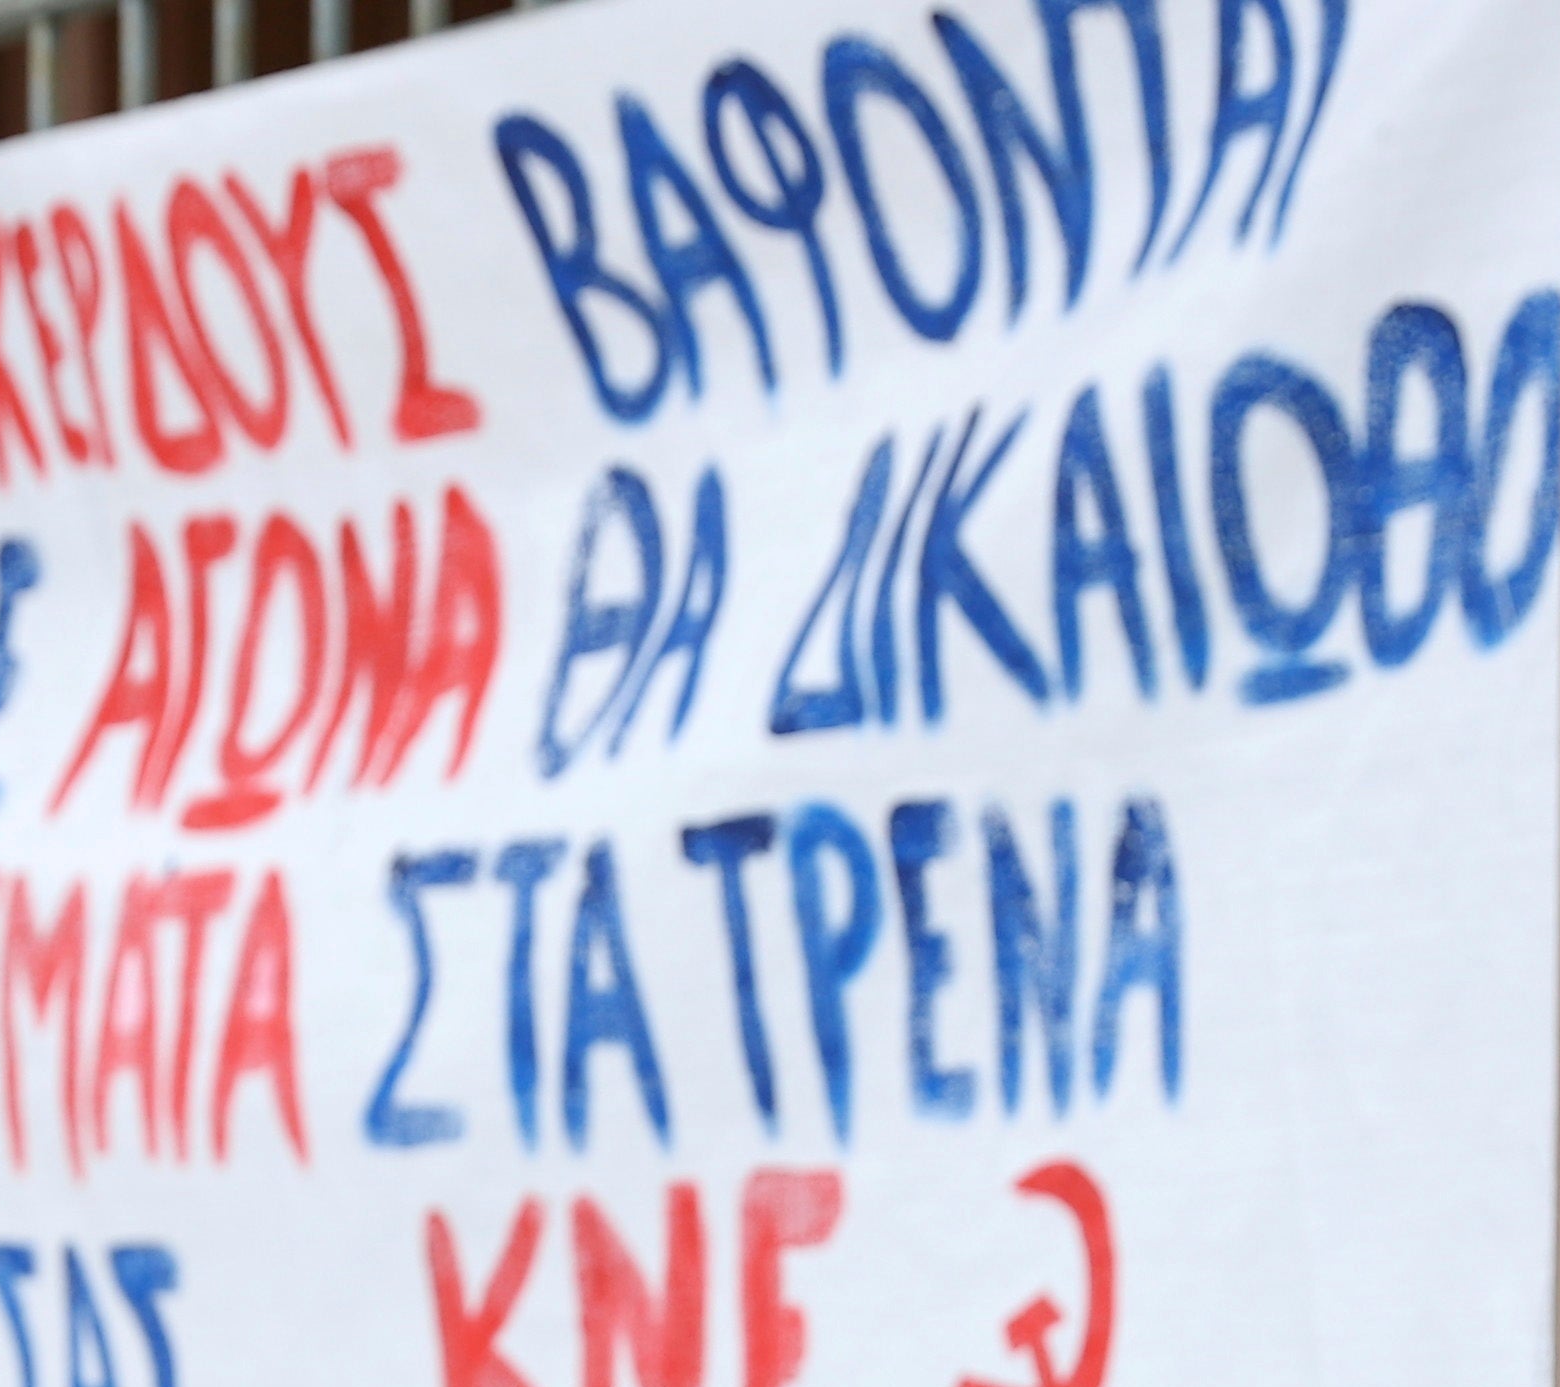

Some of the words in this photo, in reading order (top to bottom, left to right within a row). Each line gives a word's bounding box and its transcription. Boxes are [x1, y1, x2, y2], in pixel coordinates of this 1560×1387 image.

[494, 0, 1352, 425] ΒΑΦΟΝΤΑΙ
[536, 462, 730, 784] ΘΑ
[360, 832, 676, 1156] ΣΤΑ
[678, 794, 1185, 1153] ΤΡΕΝΑ
